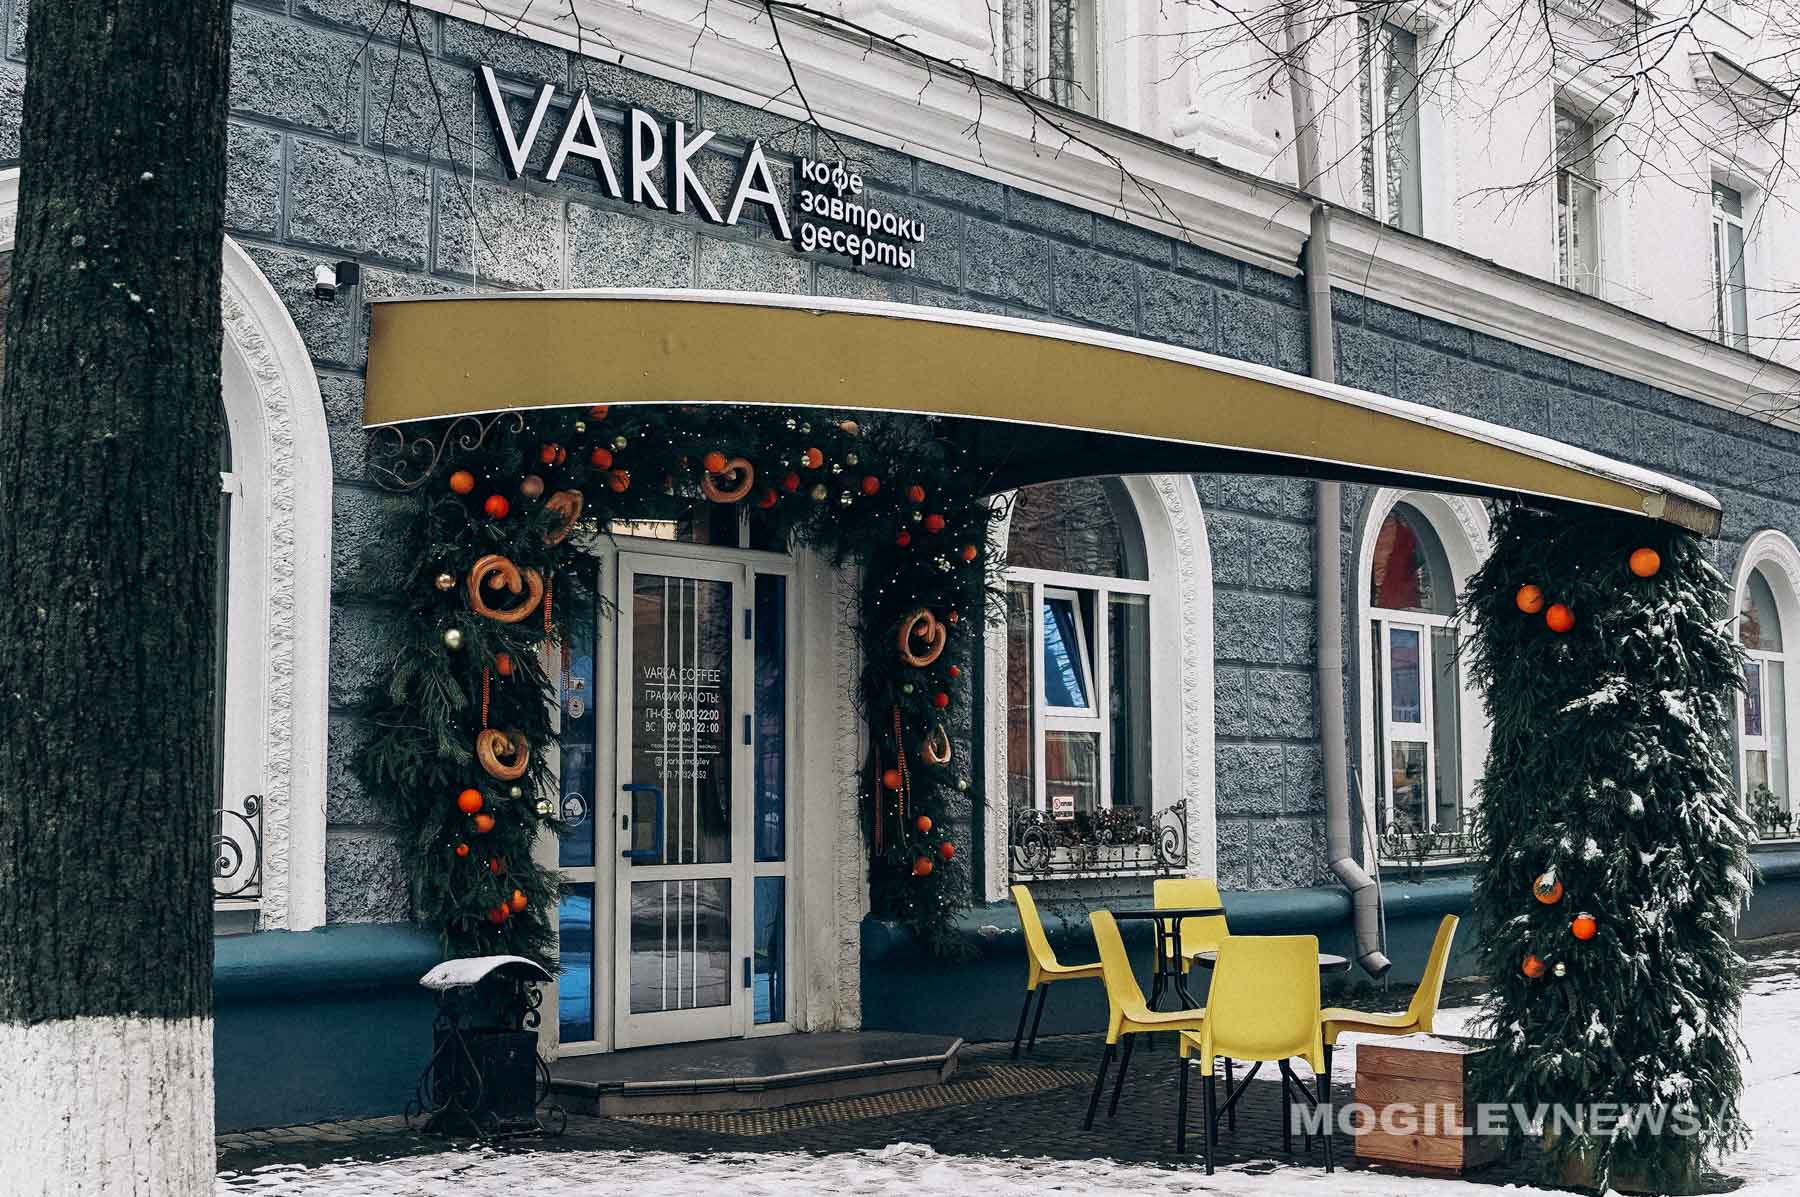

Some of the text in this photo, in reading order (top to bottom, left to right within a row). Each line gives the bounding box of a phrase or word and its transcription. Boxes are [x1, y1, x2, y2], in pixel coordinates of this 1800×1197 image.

[480, 65, 793, 240] VARKA
[801, 158, 864, 197] кофе
[800, 190, 925, 242] завтраки
[800, 222, 916, 269] десерты
[643, 666, 721, 682] VARKA COFFEE
